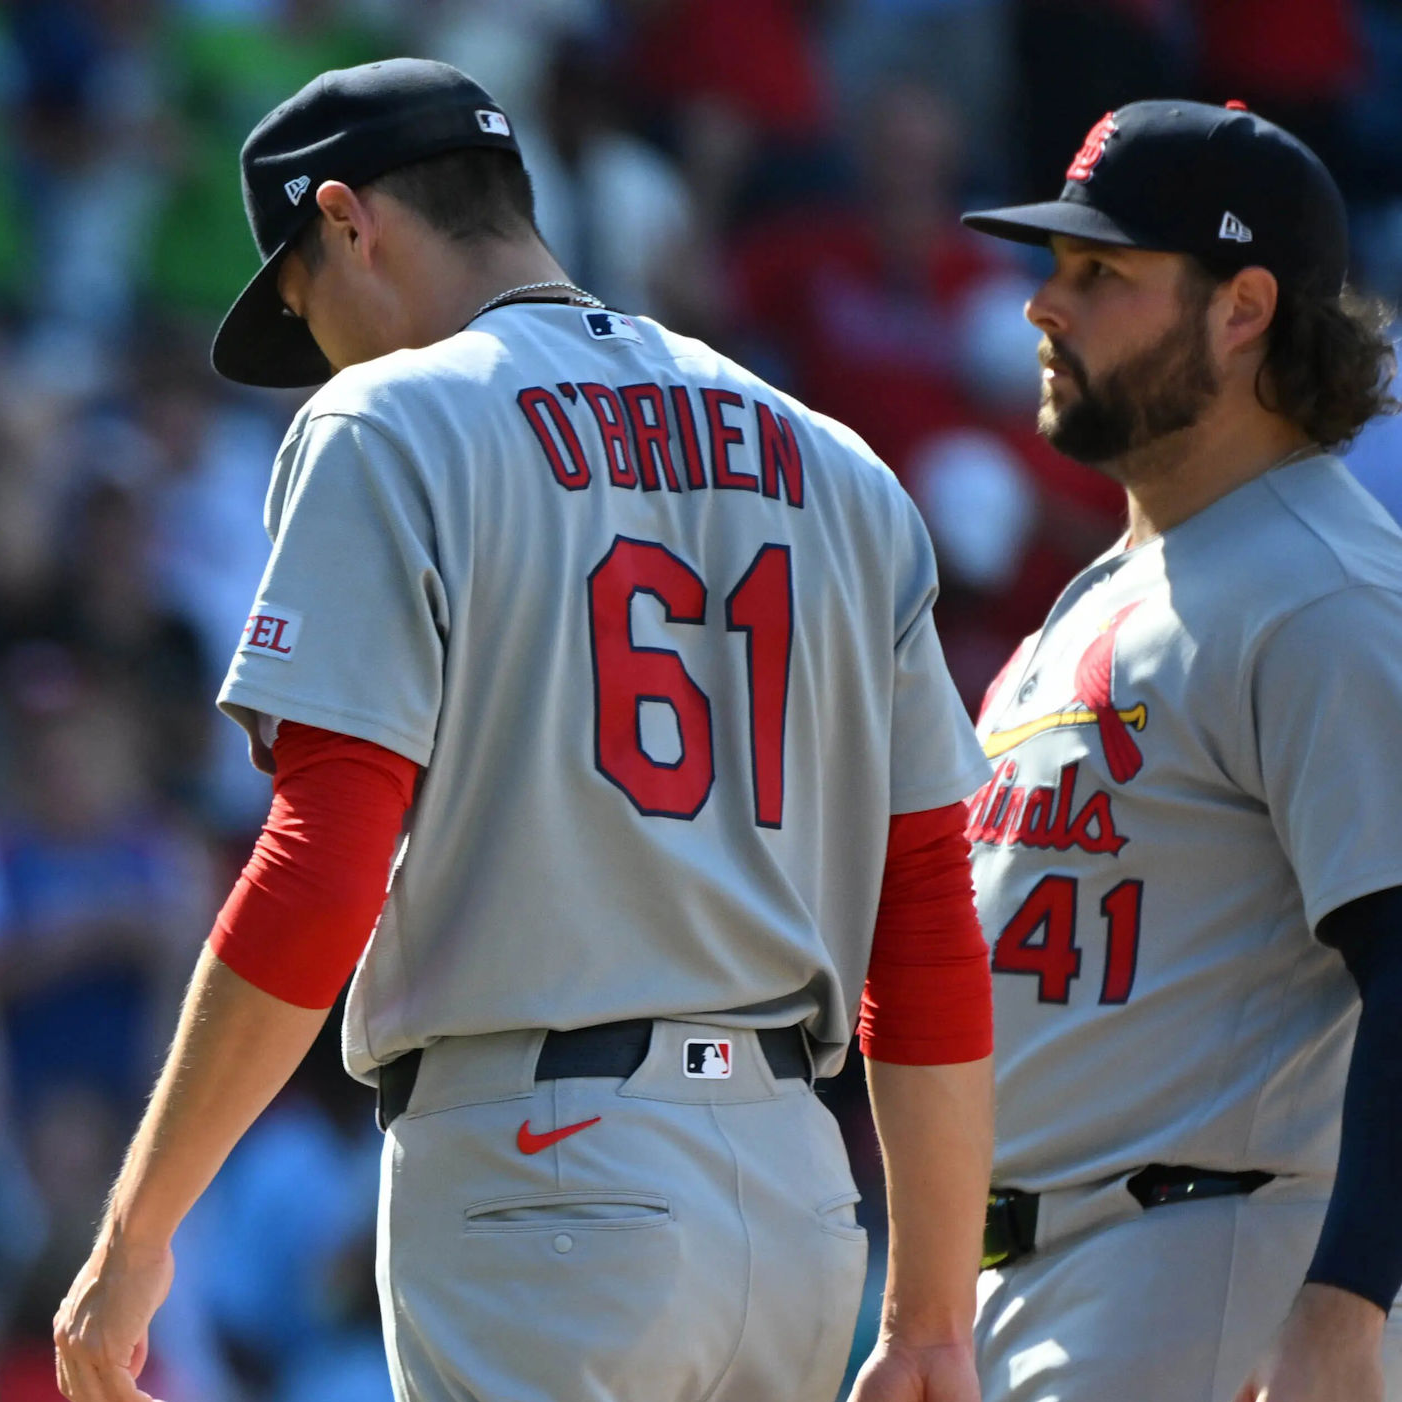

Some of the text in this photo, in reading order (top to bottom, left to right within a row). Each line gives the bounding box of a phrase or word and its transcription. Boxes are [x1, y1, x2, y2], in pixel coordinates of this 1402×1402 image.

[517, 382, 805, 508] O'BRIEN
[243, 615, 292, 654] EL
[587, 534, 793, 830] 61
[963, 757, 1130, 858] dinals
[991, 875, 1144, 1006] 41
